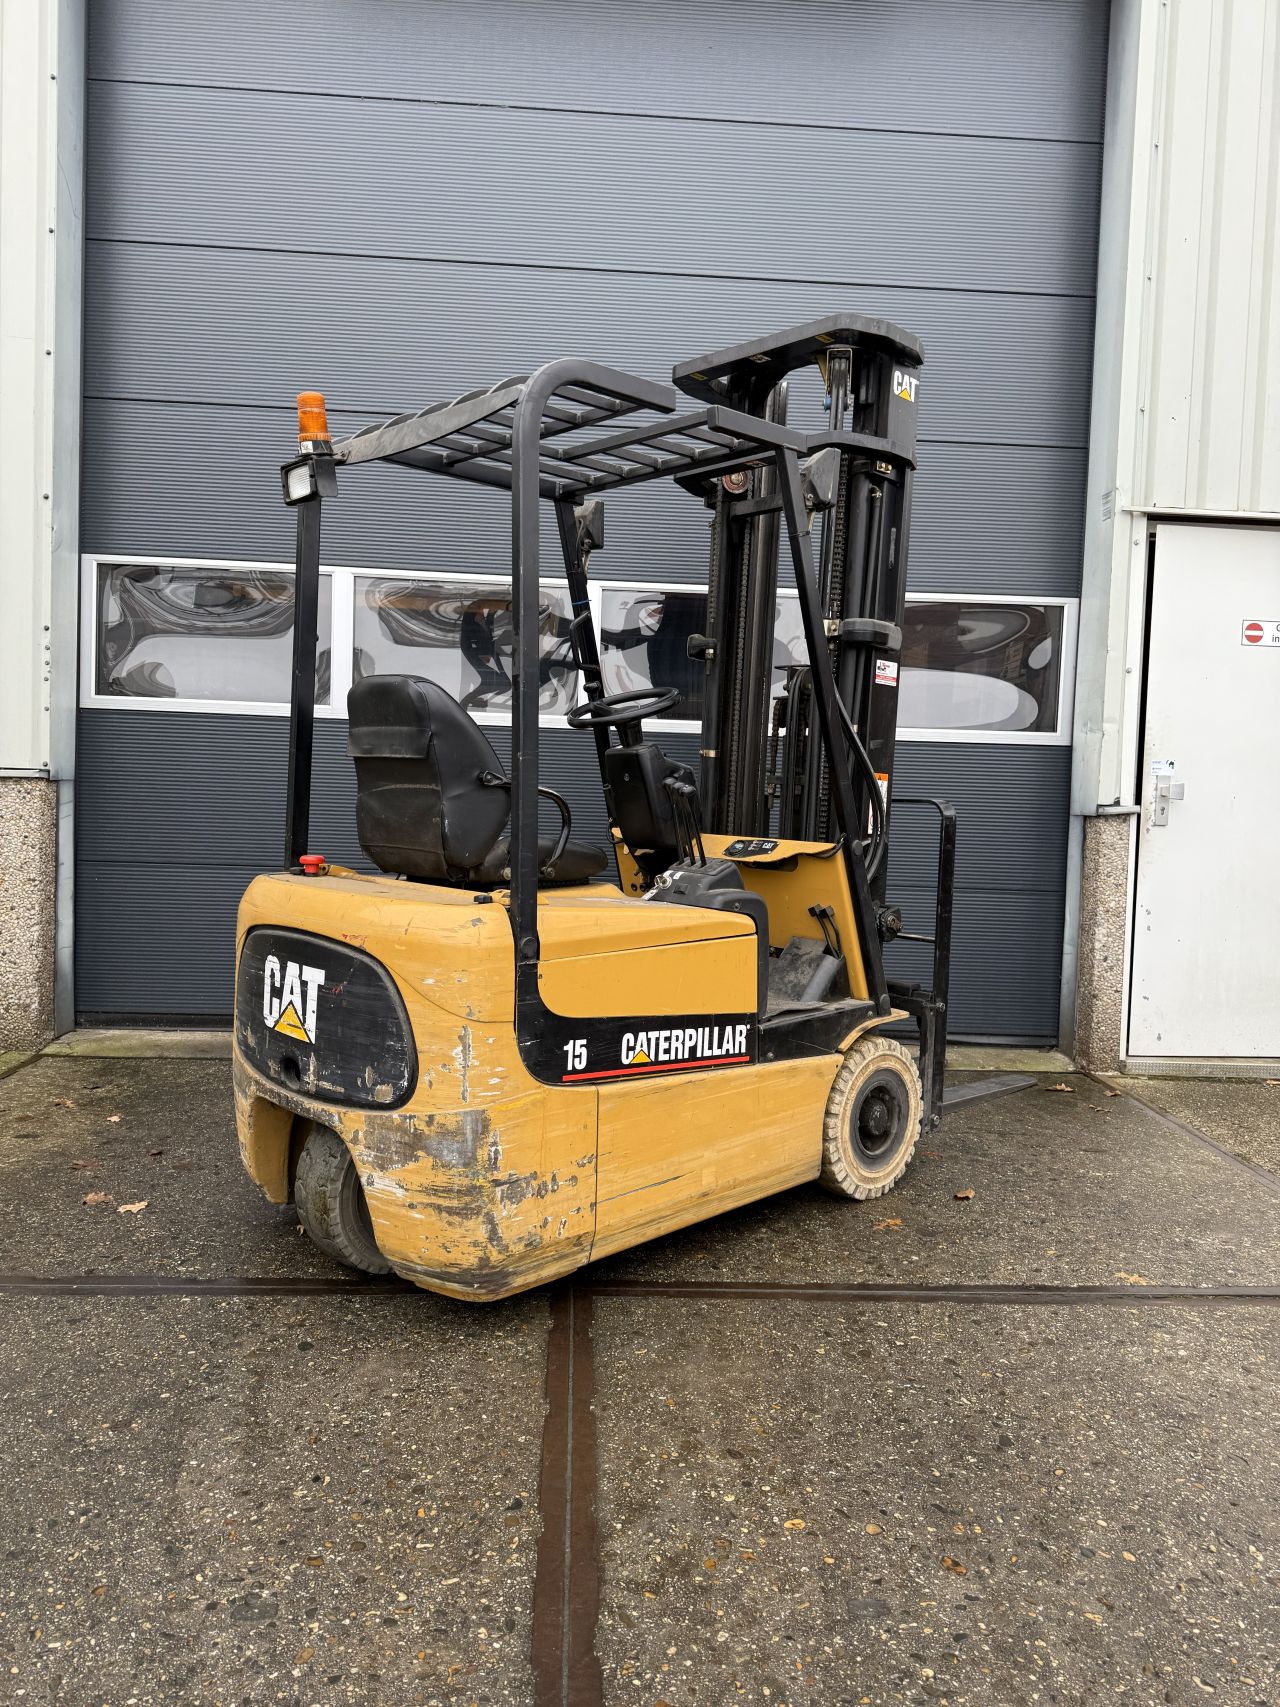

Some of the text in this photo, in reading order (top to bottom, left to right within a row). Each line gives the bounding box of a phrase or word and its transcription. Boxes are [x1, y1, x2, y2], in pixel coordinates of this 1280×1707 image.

[893, 370, 920, 403] CAT
[263, 954, 326, 1044] CAT
[563, 1023, 748, 1071] 15 CATERPILLAR
